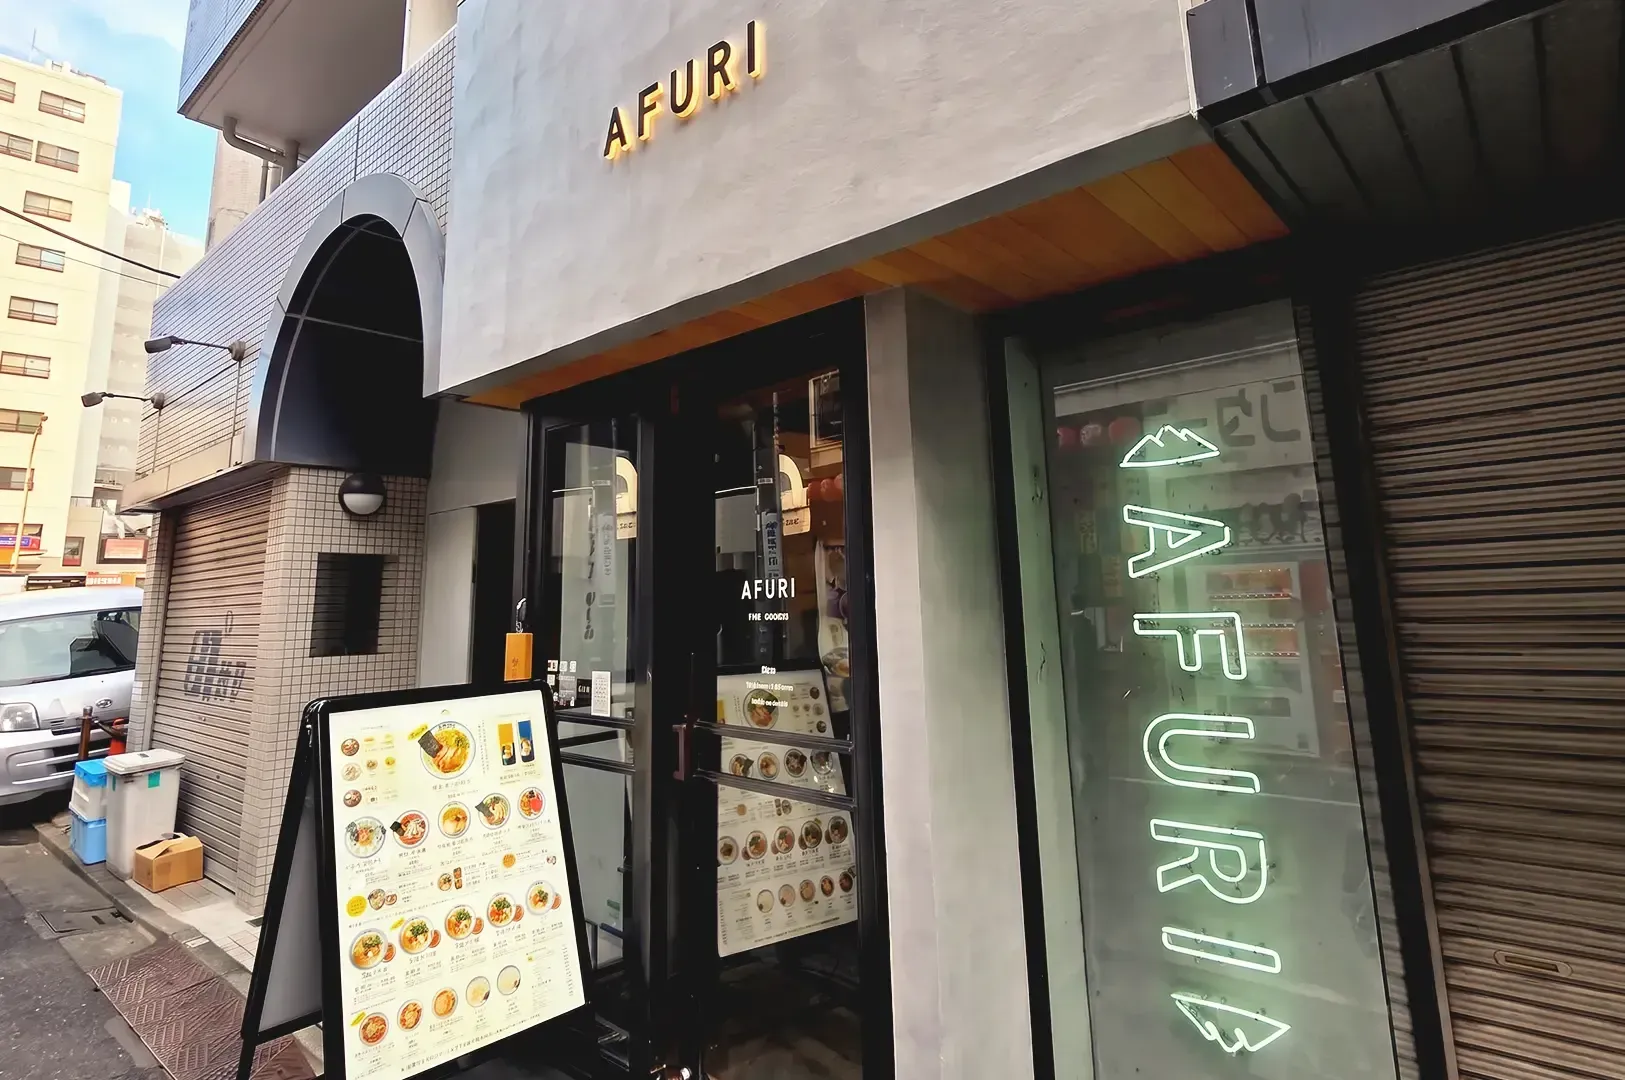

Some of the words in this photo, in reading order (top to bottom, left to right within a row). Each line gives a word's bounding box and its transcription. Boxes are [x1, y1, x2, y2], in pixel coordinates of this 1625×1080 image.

[603, 19, 761, 160] AFURI
[741, 577, 795, 600] AFURI
[1123, 504, 1282, 974] AFURI
